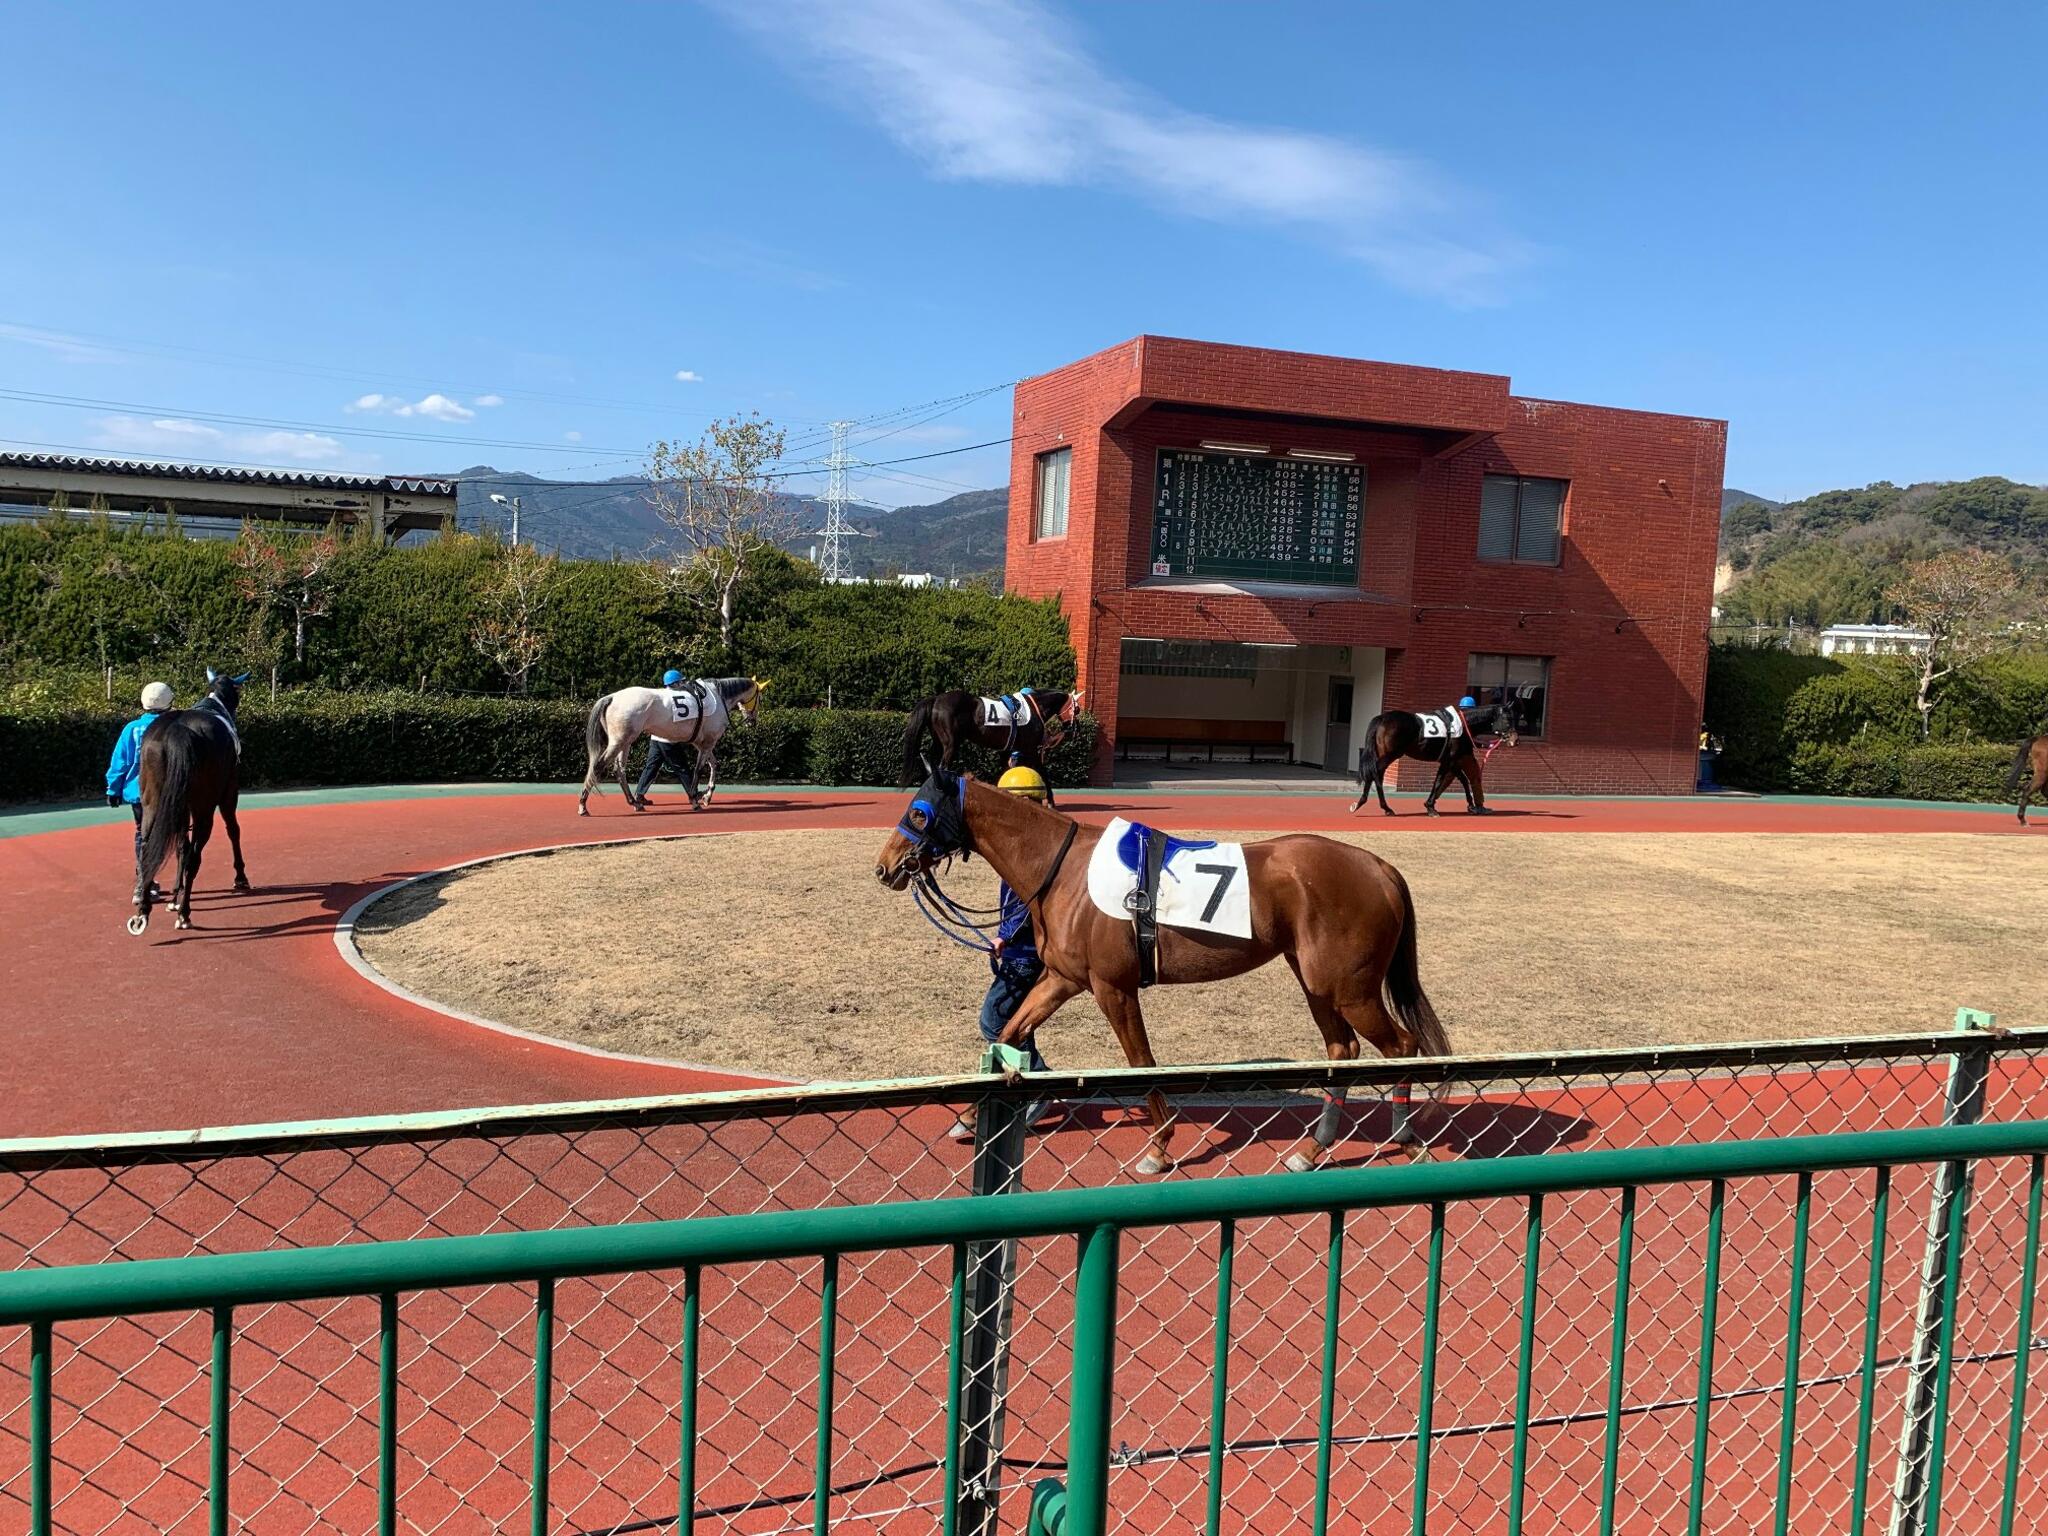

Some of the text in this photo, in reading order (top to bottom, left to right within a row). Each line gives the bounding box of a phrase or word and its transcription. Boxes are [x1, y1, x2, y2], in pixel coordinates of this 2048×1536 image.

[1182, 463, 1185, 471] 1
[1195, 464, 1198, 472] 1
[1180, 472, 1185, 480] 2
[1193, 473, 1199, 481] 2
[1179, 481, 1185, 489] 3
[1192, 482, 1198, 491] 3
[1178, 491, 1184, 499] 4
[1273, 498, 1294, 506] 464
[1272, 516, 1294, 524] 438
[1189, 529, 1195, 537] 8
[1271, 526, 1292, 534] 428
[1188, 538, 1195, 546] 9
[1186, 565, 1194, 573] 12
[672, 696, 689, 717] 5
[988, 704, 1000, 723] 4
[1426, 718, 1439, 735] 3
[1194, 864, 1238, 923] 7
